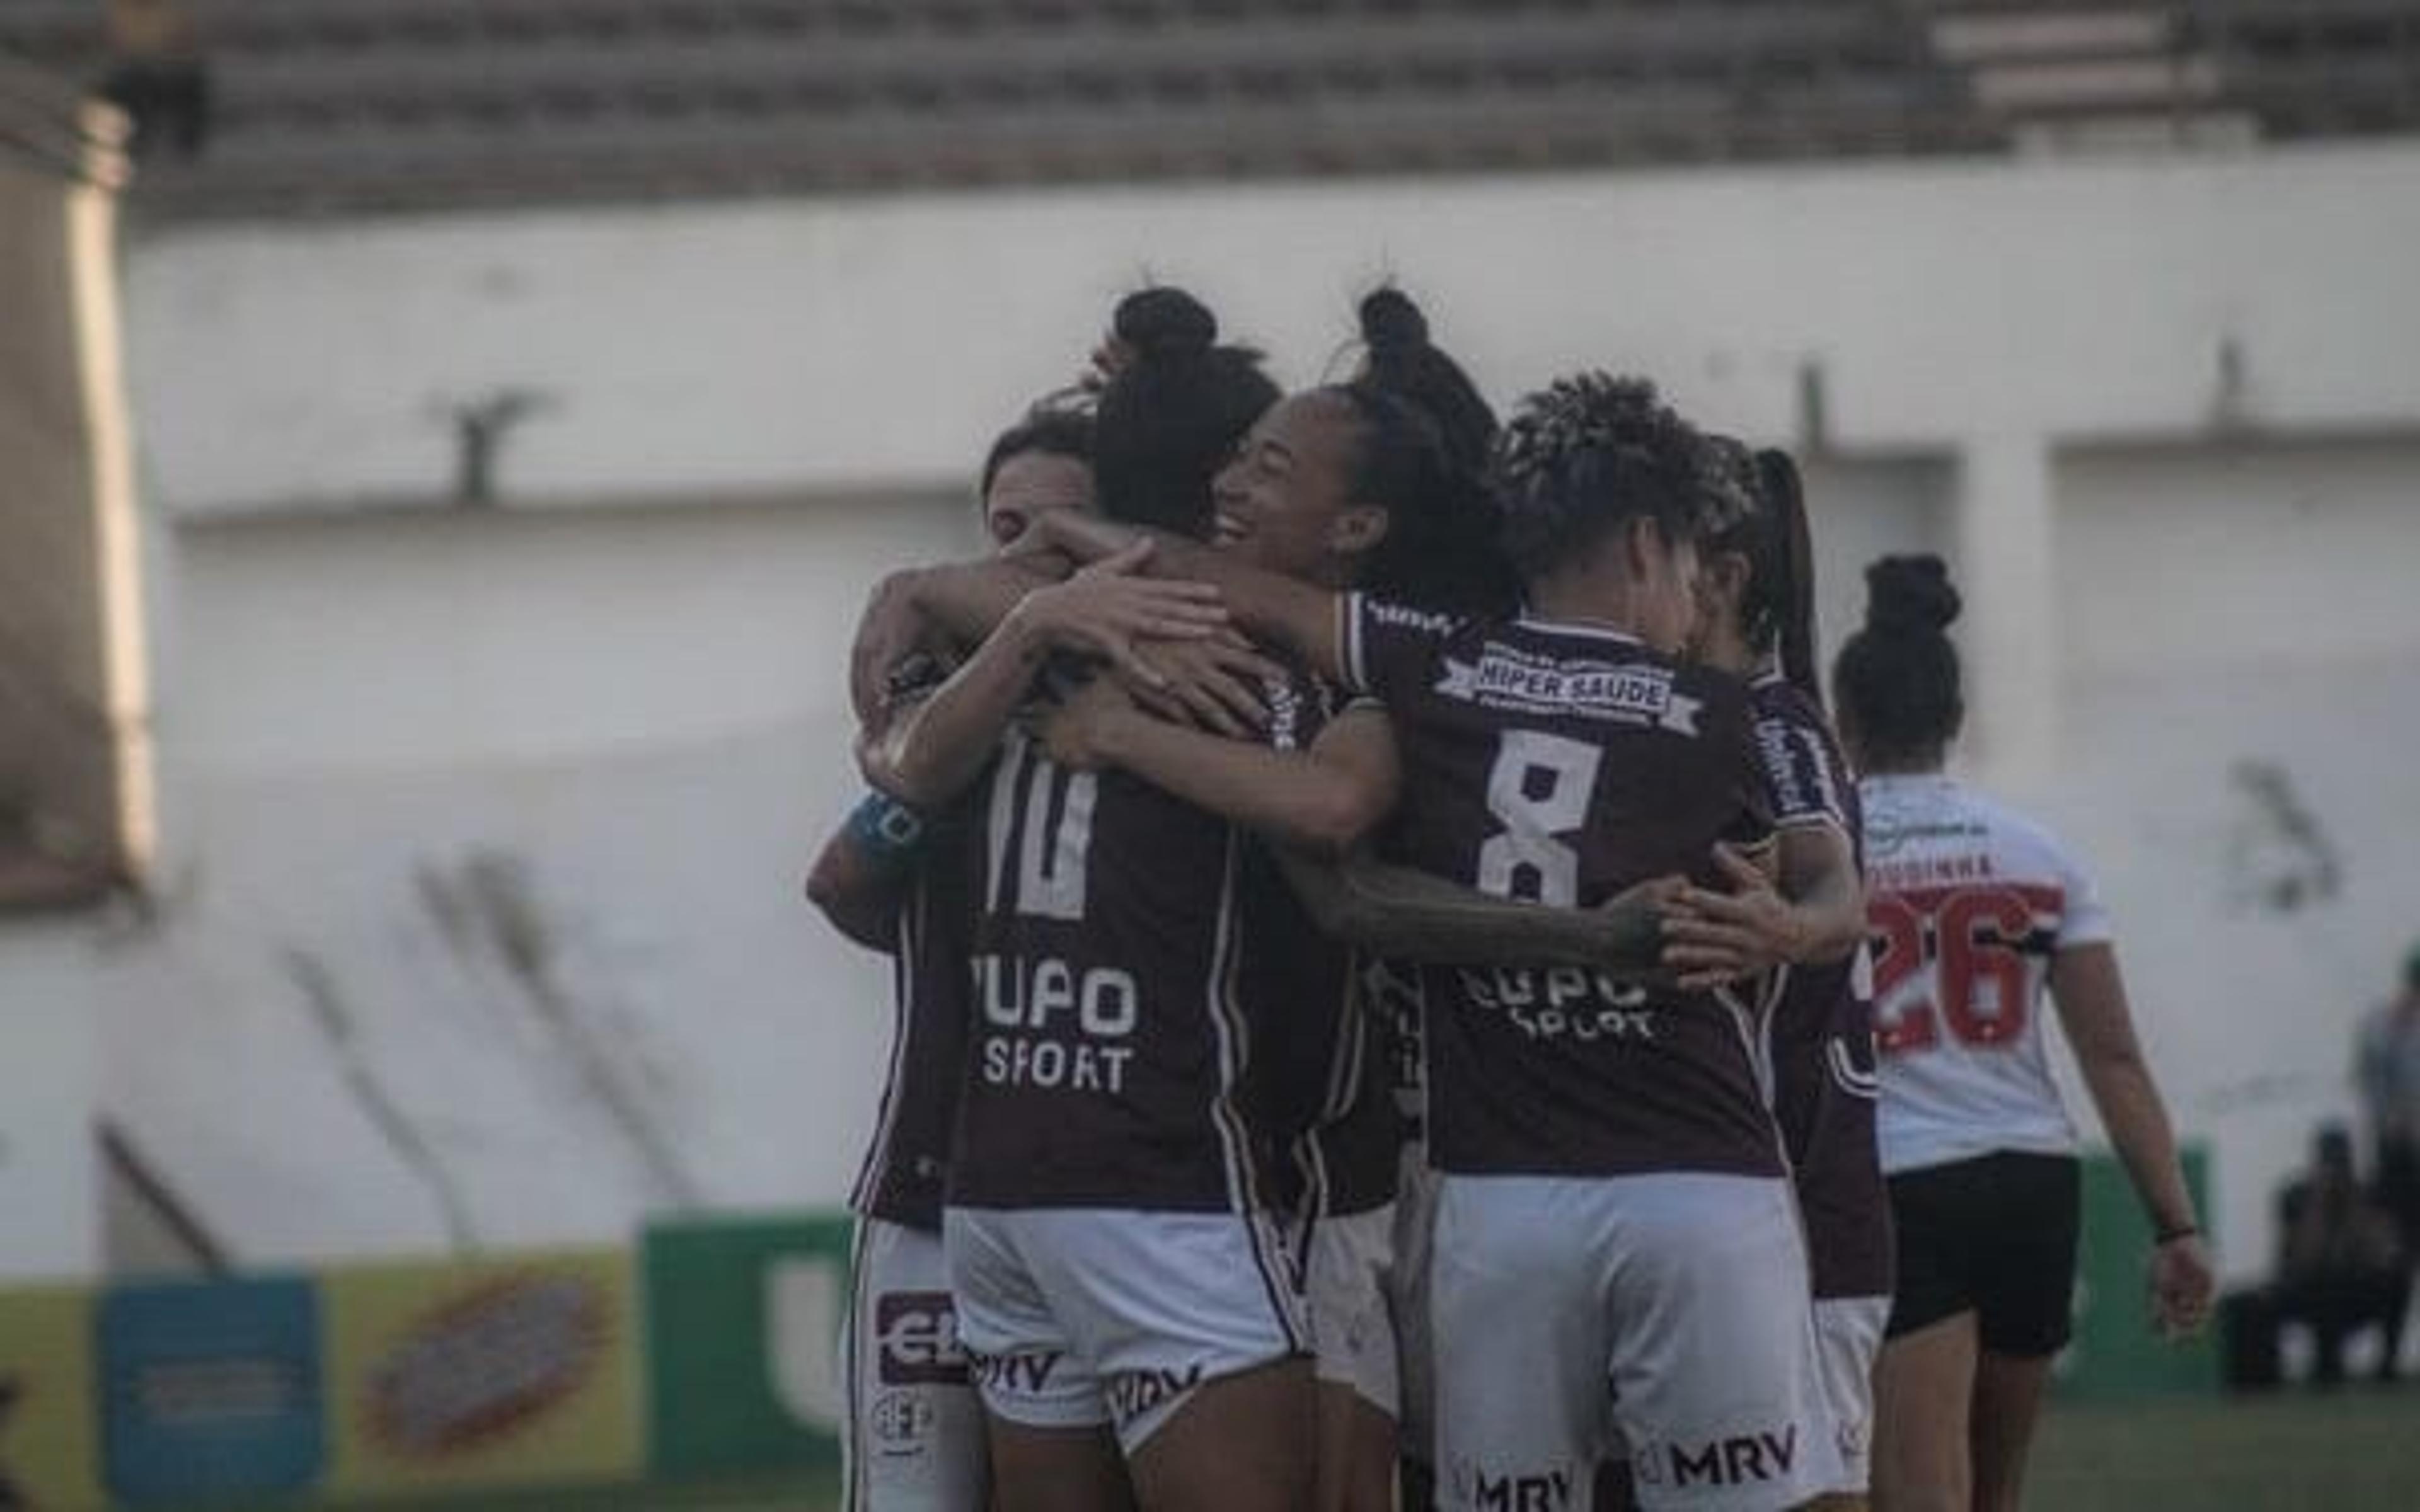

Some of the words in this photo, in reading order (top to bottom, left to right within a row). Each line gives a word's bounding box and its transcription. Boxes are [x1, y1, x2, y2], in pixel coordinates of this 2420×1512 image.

[1478, 655, 1562, 695] HIPER
[1477, 728, 1603, 910] 8
[1867, 887, 2034, 1051] 26
[983, 1037, 1133, 1095] SPORT
[1669, 1424, 1797, 1487] MRV
